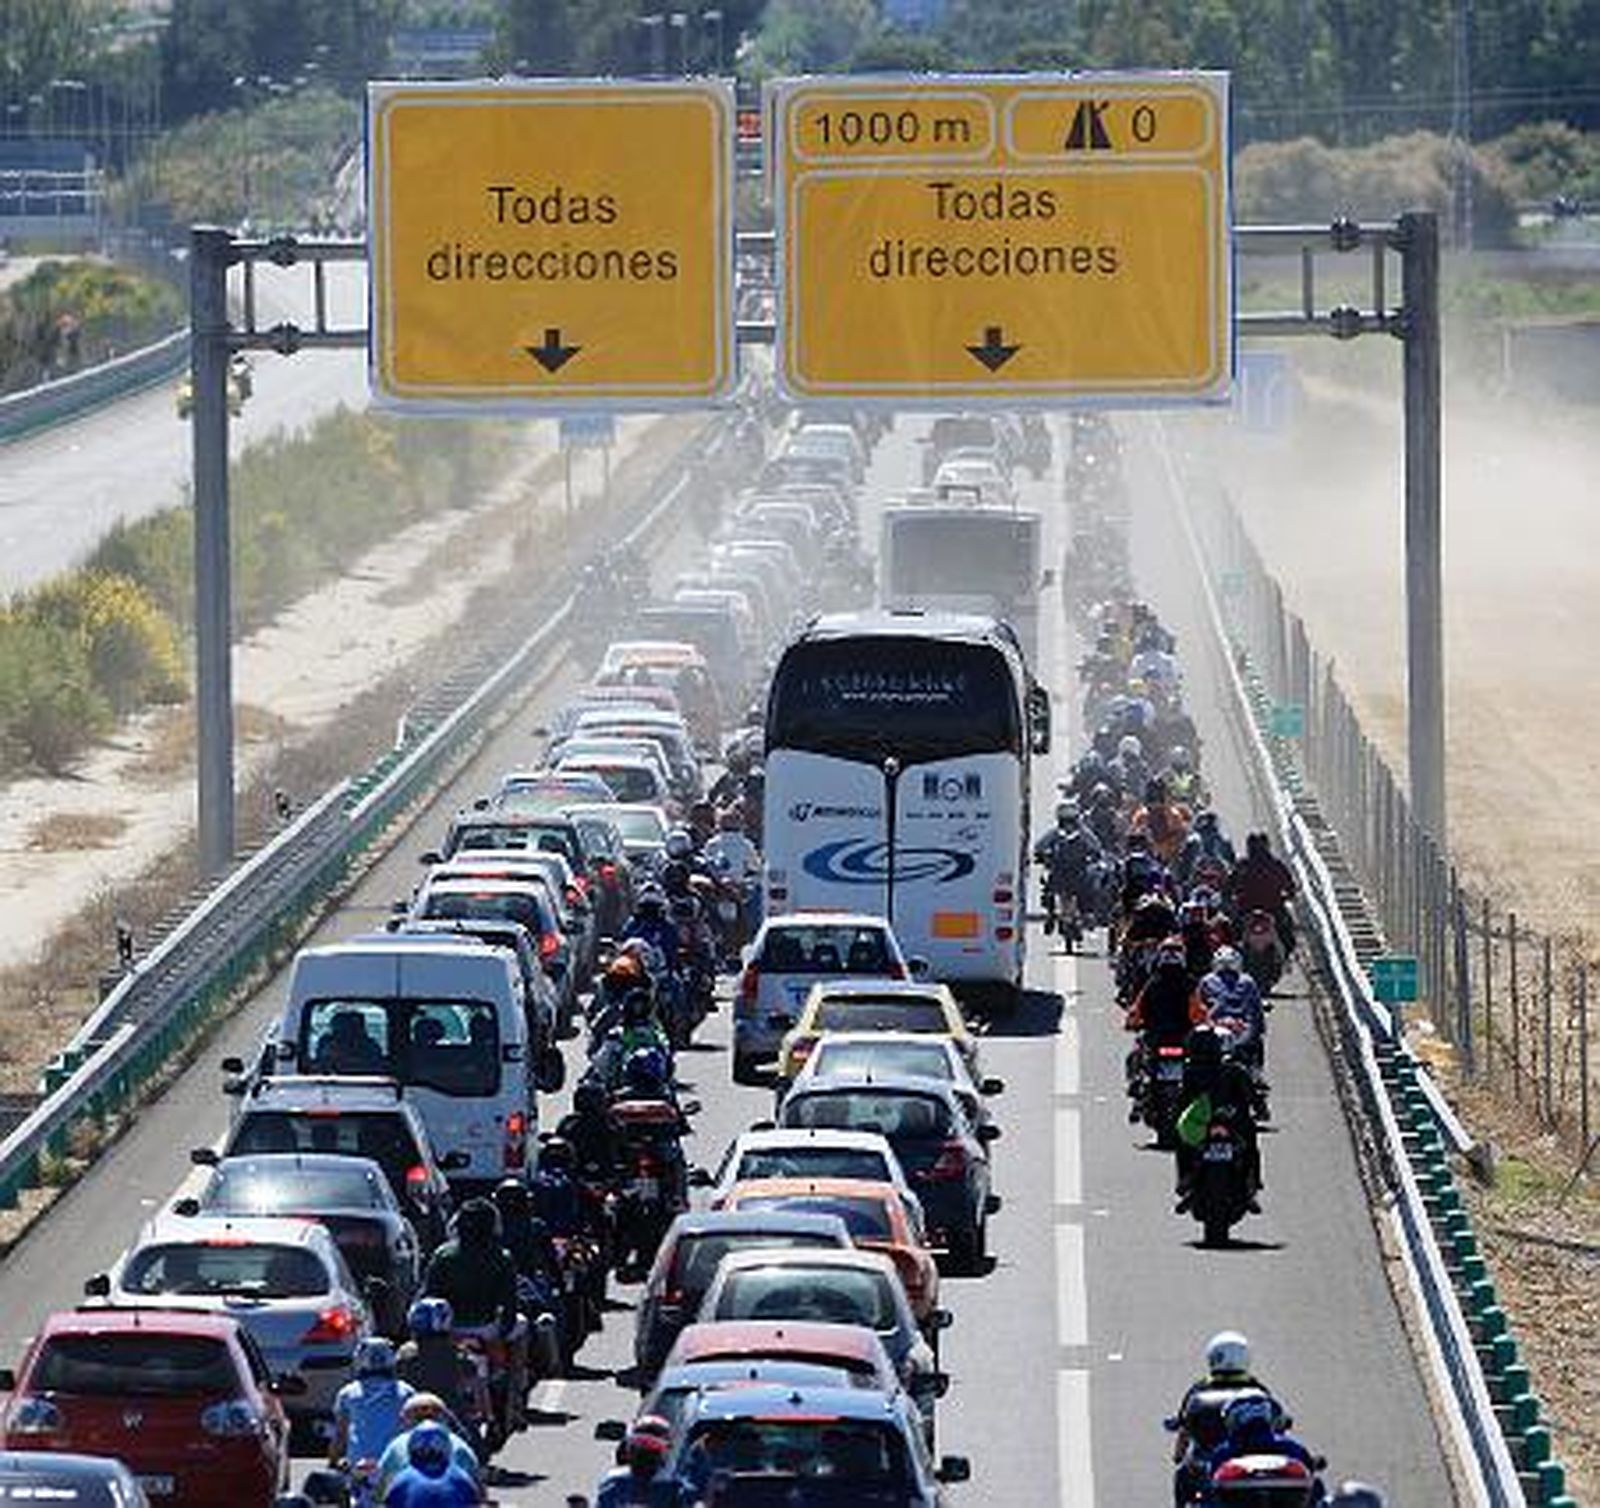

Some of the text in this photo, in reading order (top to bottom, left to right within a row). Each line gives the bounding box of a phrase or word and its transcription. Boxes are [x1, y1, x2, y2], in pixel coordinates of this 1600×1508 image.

[814, 109, 972, 147] 1000 m
[1130, 104, 1157, 144] 0
[486, 185, 619, 226] Todas
[927, 180, 1057, 221] Todas
[426, 241, 679, 283] direcciones
[868, 237, 1119, 279] direcciones
